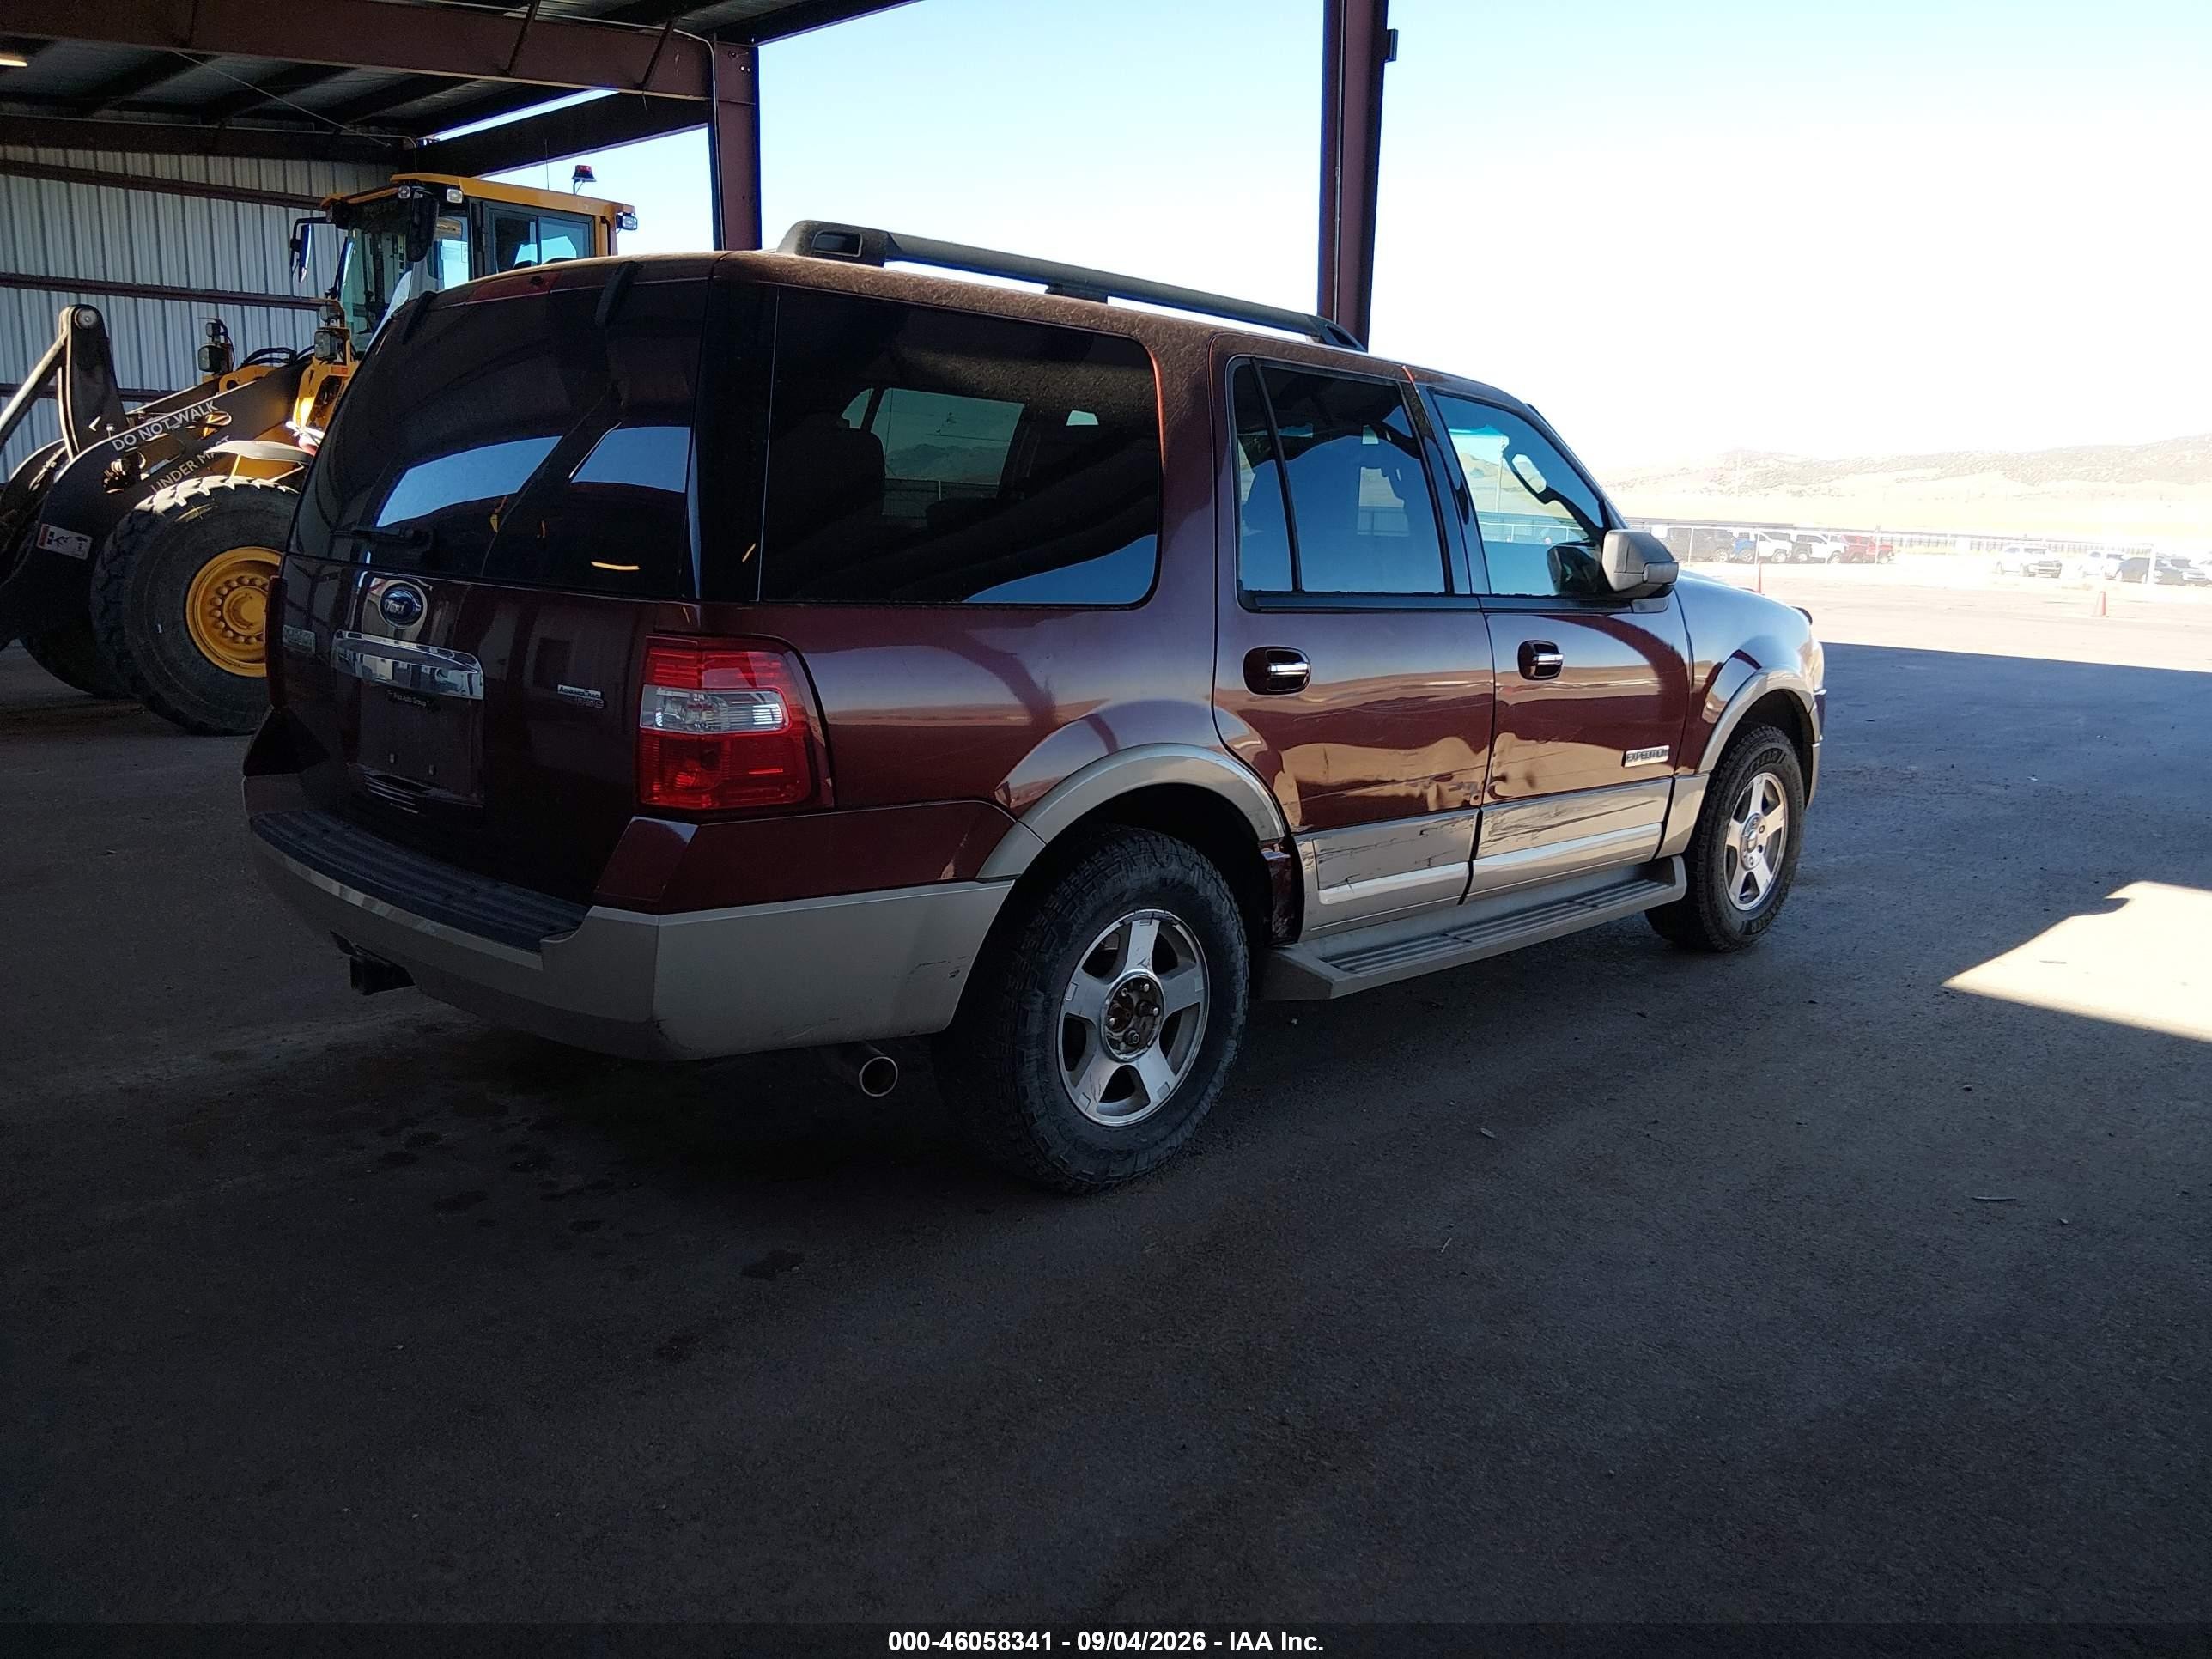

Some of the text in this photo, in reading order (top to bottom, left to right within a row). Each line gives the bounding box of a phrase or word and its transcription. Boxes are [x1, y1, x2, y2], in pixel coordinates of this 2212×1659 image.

[111, 400, 219, 452] DO NOT WALK
[150, 460, 198, 493] UNDER
[1626, 748, 1669, 763] EXPEDITION
